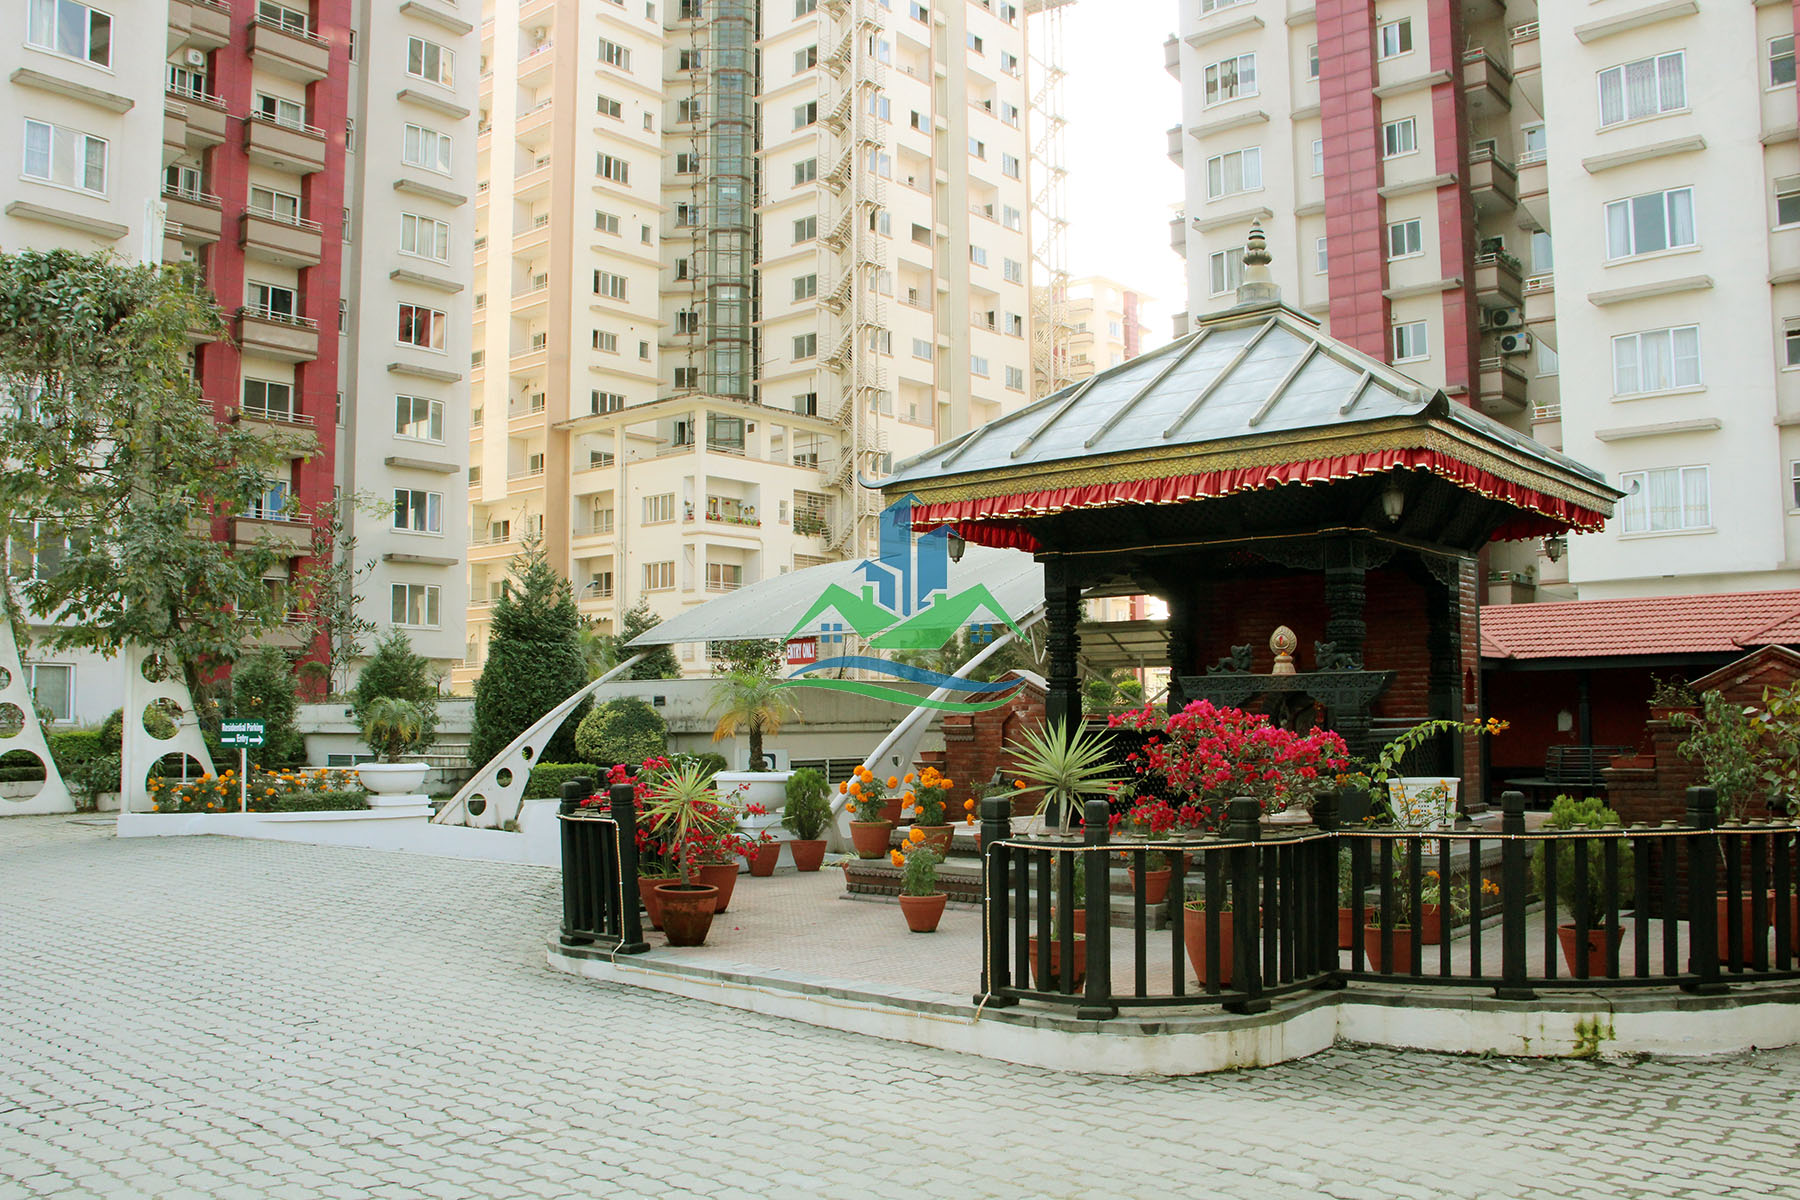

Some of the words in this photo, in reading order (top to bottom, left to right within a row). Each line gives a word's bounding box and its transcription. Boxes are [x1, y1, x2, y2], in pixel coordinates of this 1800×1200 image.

[787, 643, 801, 659] ENTRY
[802, 642, 815, 658] ONLY
[221, 722, 246, 732] Residential
[247, 722, 264, 734] Parking
[236, 734, 249, 745] Entry
